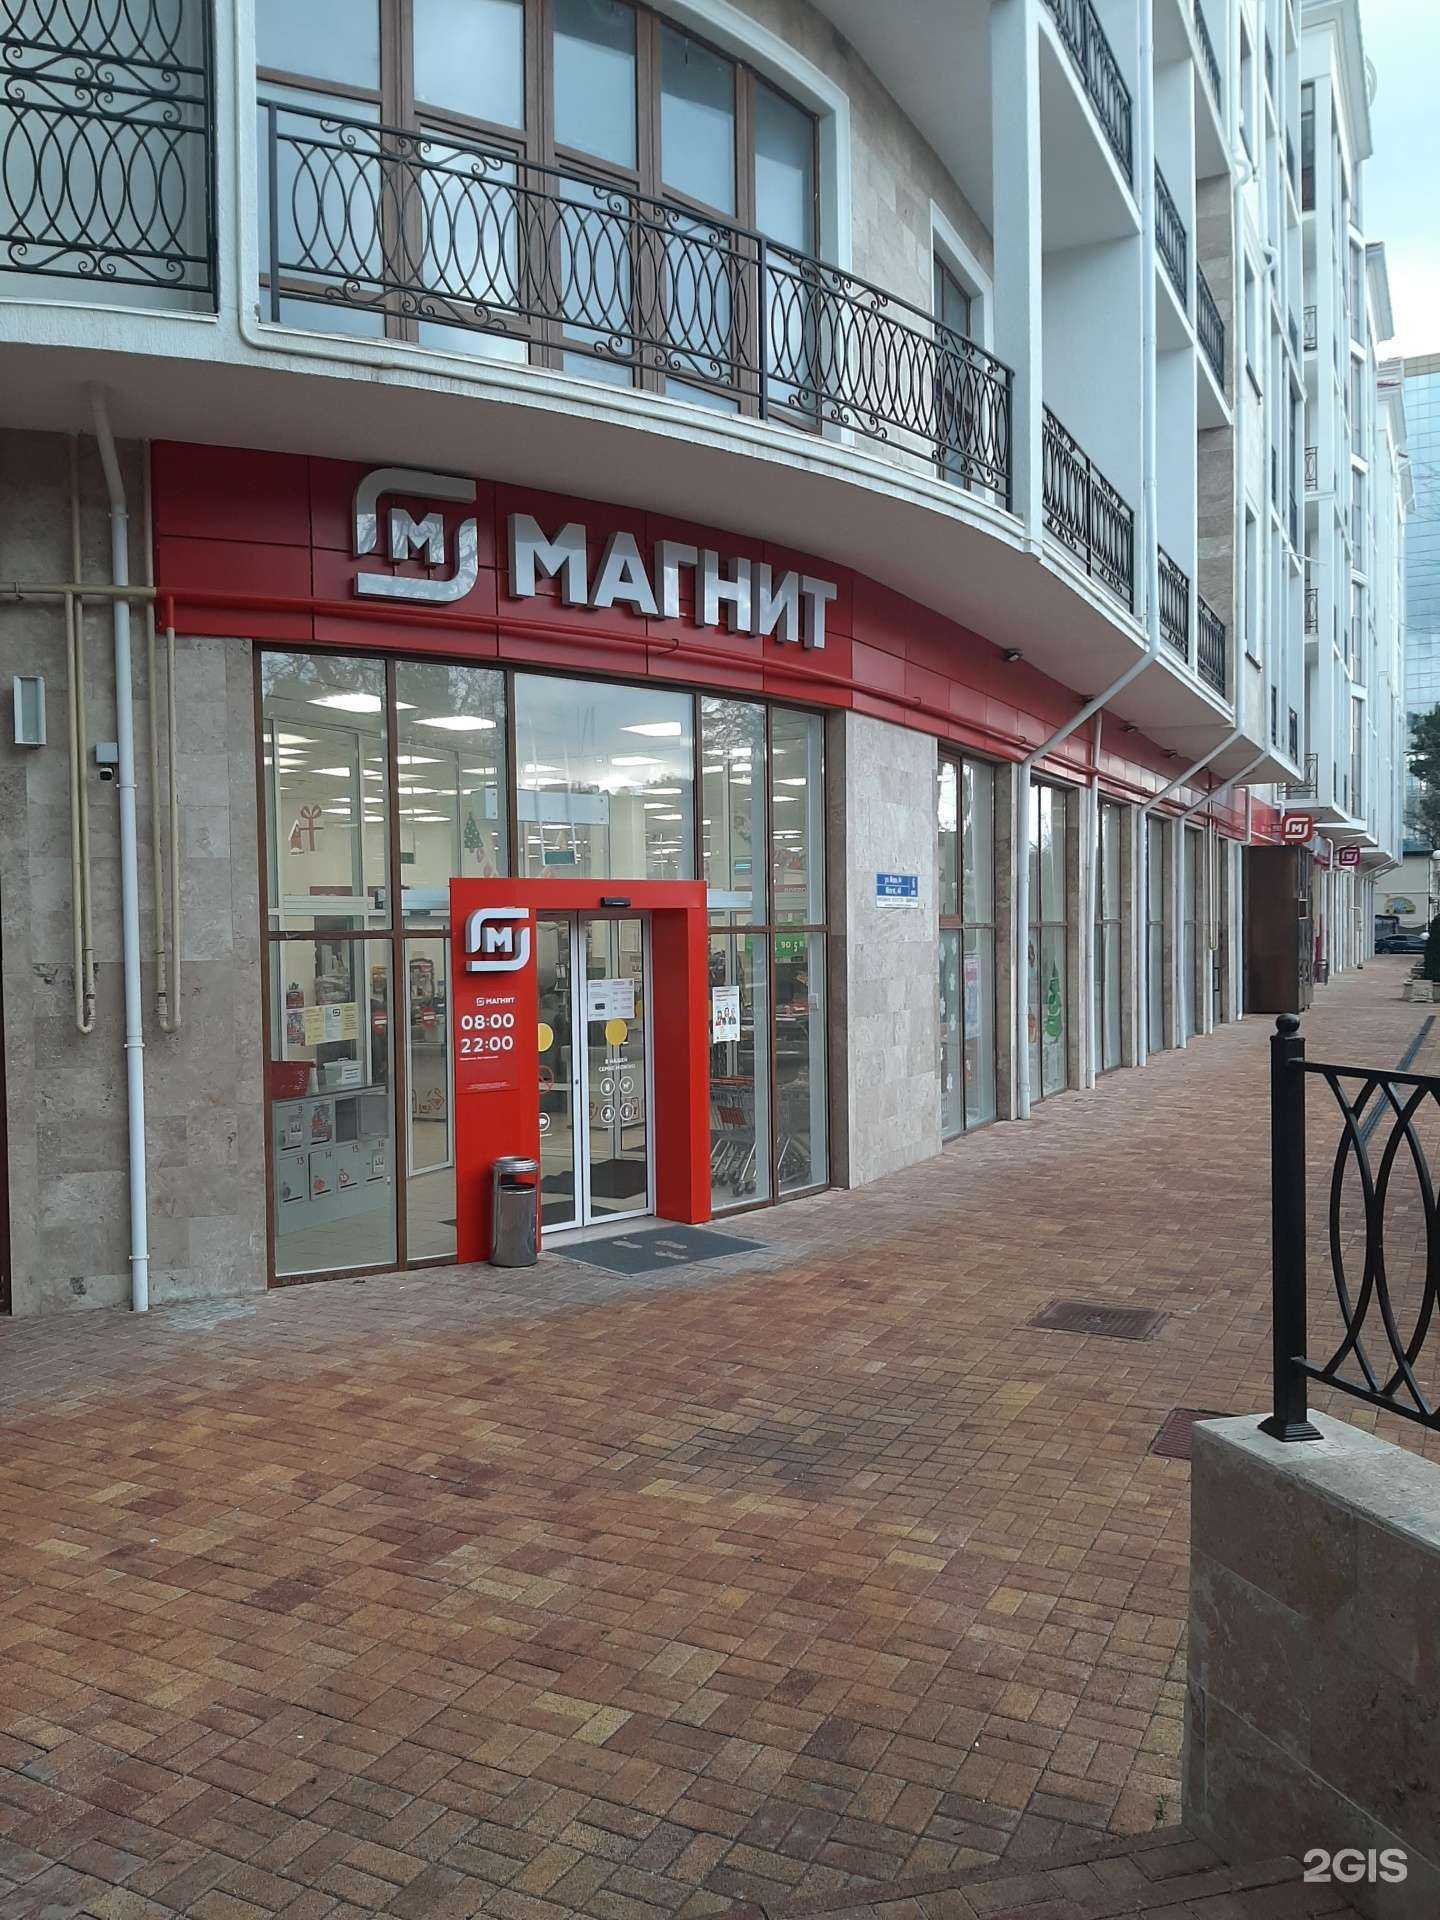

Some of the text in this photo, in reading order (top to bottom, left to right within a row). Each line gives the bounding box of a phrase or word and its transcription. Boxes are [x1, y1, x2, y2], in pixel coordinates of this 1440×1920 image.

[508, 512, 838, 649] МАГНИТ
[486, 997, 515, 1006] МАГНИТ
[461, 1013, 514, 1030] 08:00
[460, 1035, 514, 1054] 22:00
